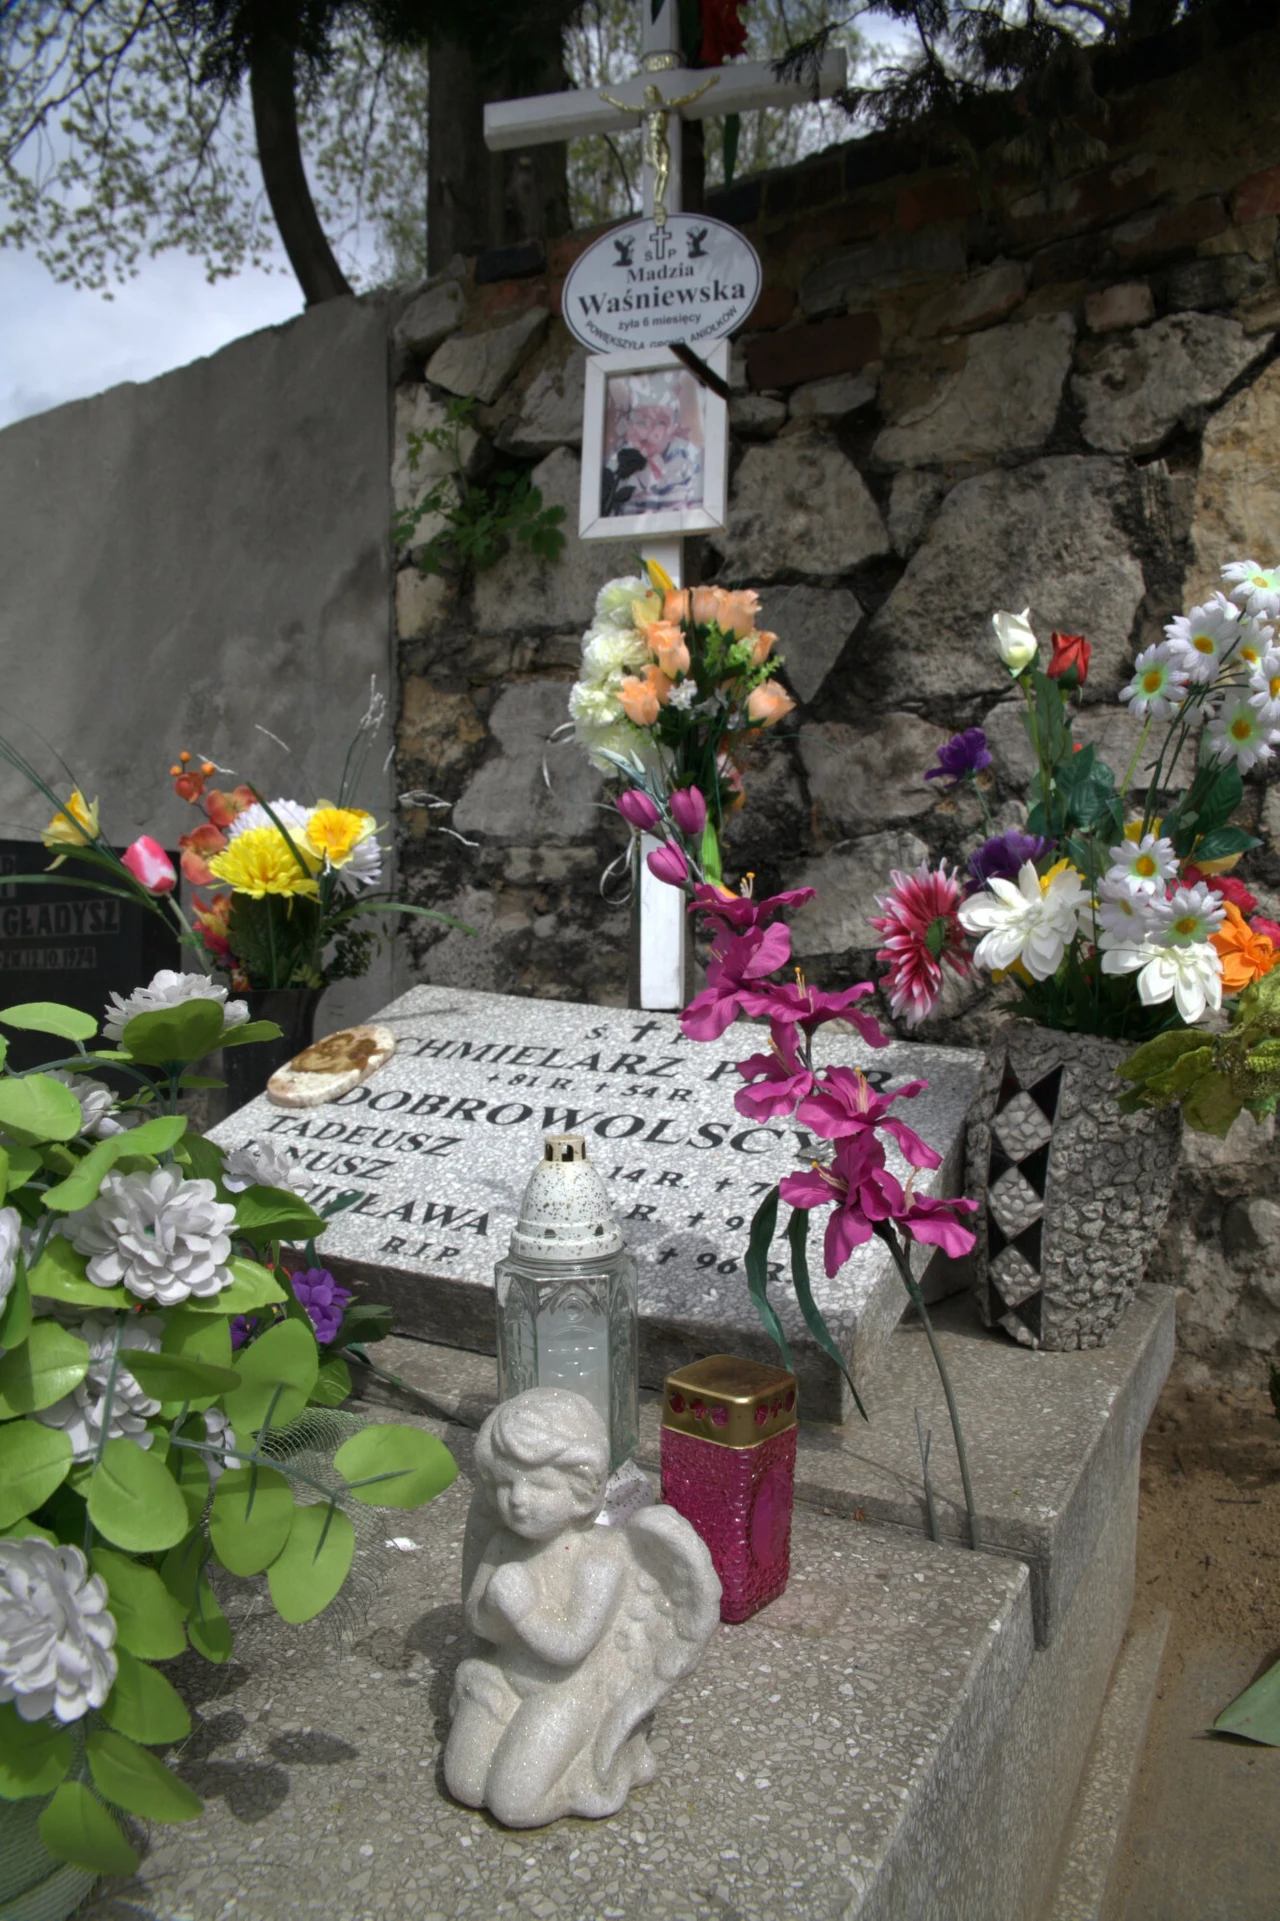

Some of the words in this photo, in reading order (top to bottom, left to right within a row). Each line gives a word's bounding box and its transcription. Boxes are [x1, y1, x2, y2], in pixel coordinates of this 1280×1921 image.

[627, 262, 694, 283] Madzia
[578, 280, 746, 316] Waśniewska
[618, 319, 640, 332] żyła
[643, 316, 650, 327] 6
[652, 313, 702, 326] miesięcy
[3, 900, 119, 937] GŁADYSZ
[507, 1073, 541, 1088] 81
[620, 1084, 660, 1099] 54
[263, 1115, 463, 1157] TADEUSZ
[607, 1165, 647, 1183] 14
[694, 1252, 741, 1275] 96
